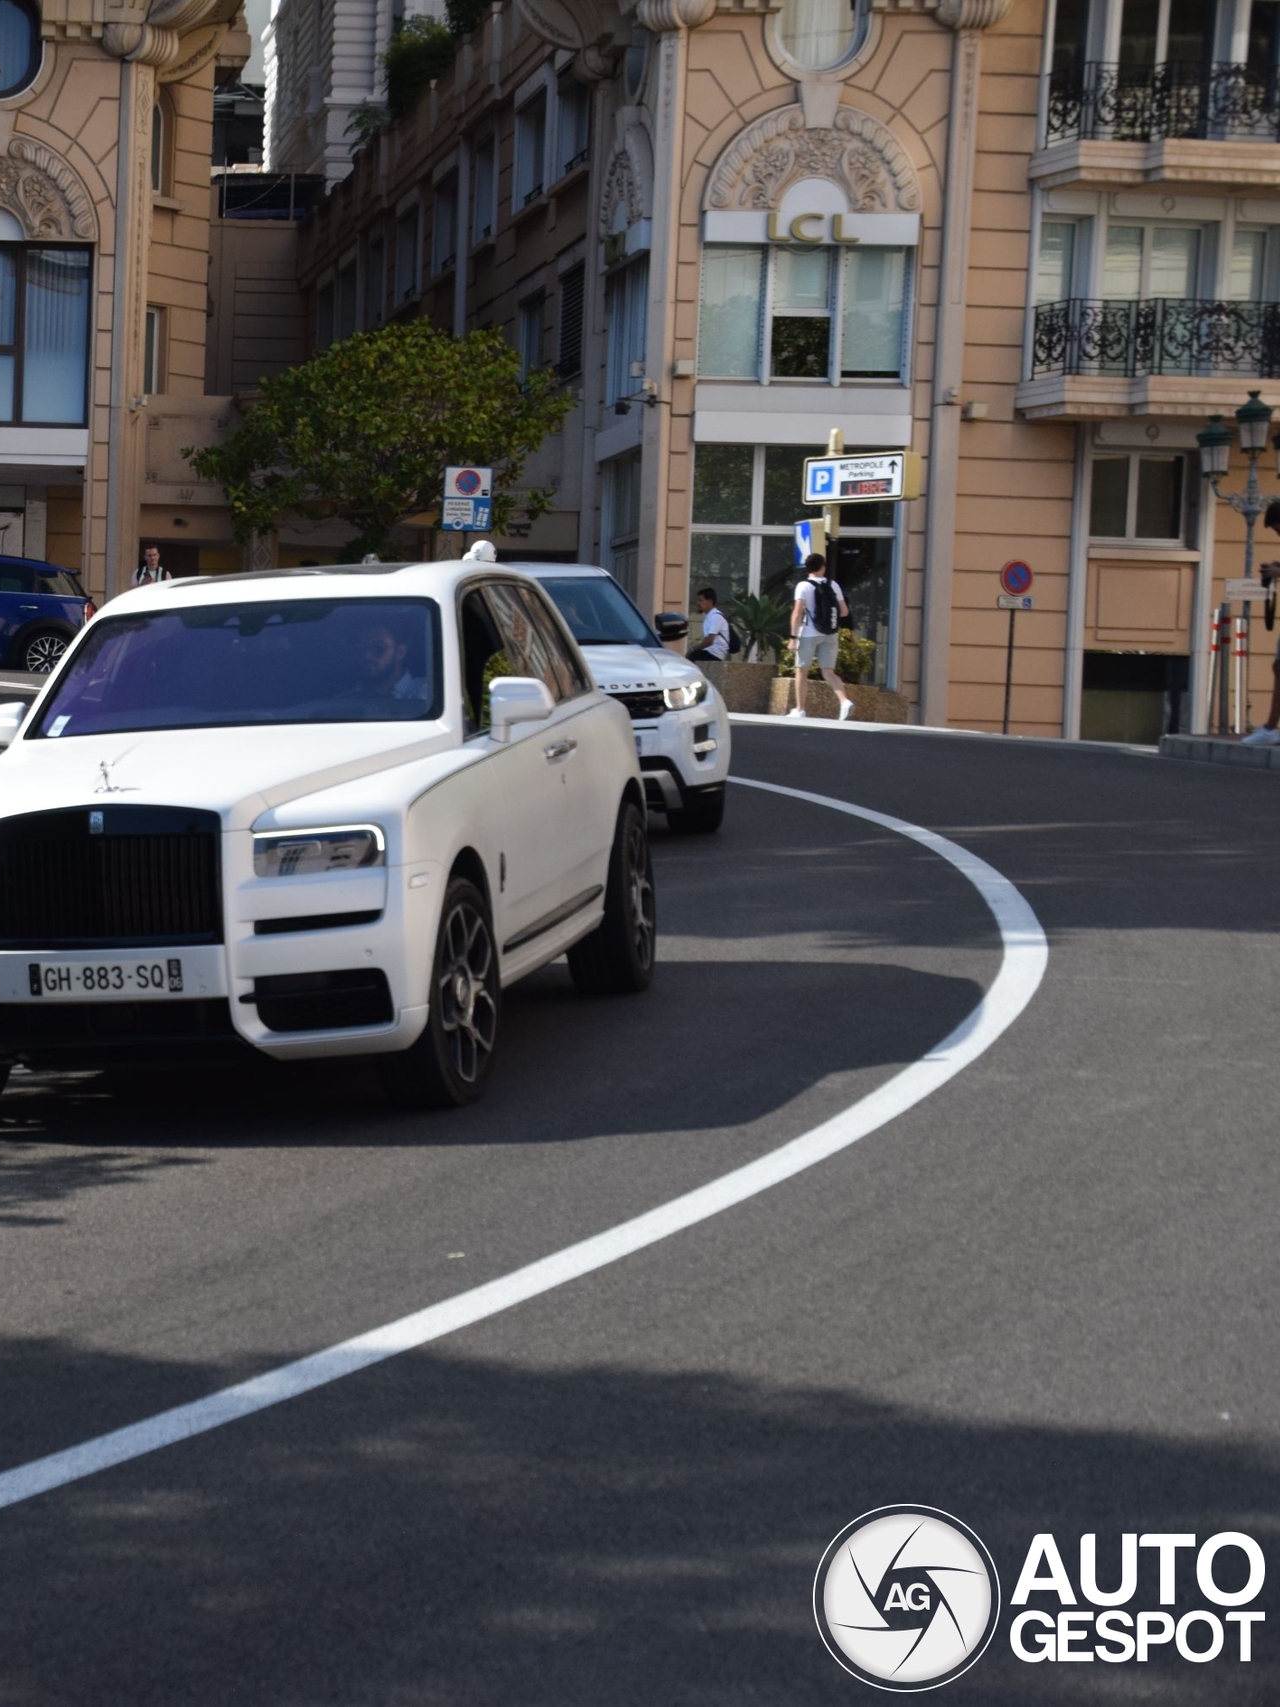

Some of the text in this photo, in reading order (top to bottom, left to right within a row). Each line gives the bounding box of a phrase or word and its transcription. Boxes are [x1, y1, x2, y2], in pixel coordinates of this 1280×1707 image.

[767, 212, 859, 243] LCL
[840, 461, 884, 471] METROPOLE
[816, 471, 829, 491] P
[848, 480, 888, 495] LIBRE
[597, 682, 657, 690] ROVER
[44, 964, 165, 992] GH-883-SQ
[170, 977, 183, 989] 06
